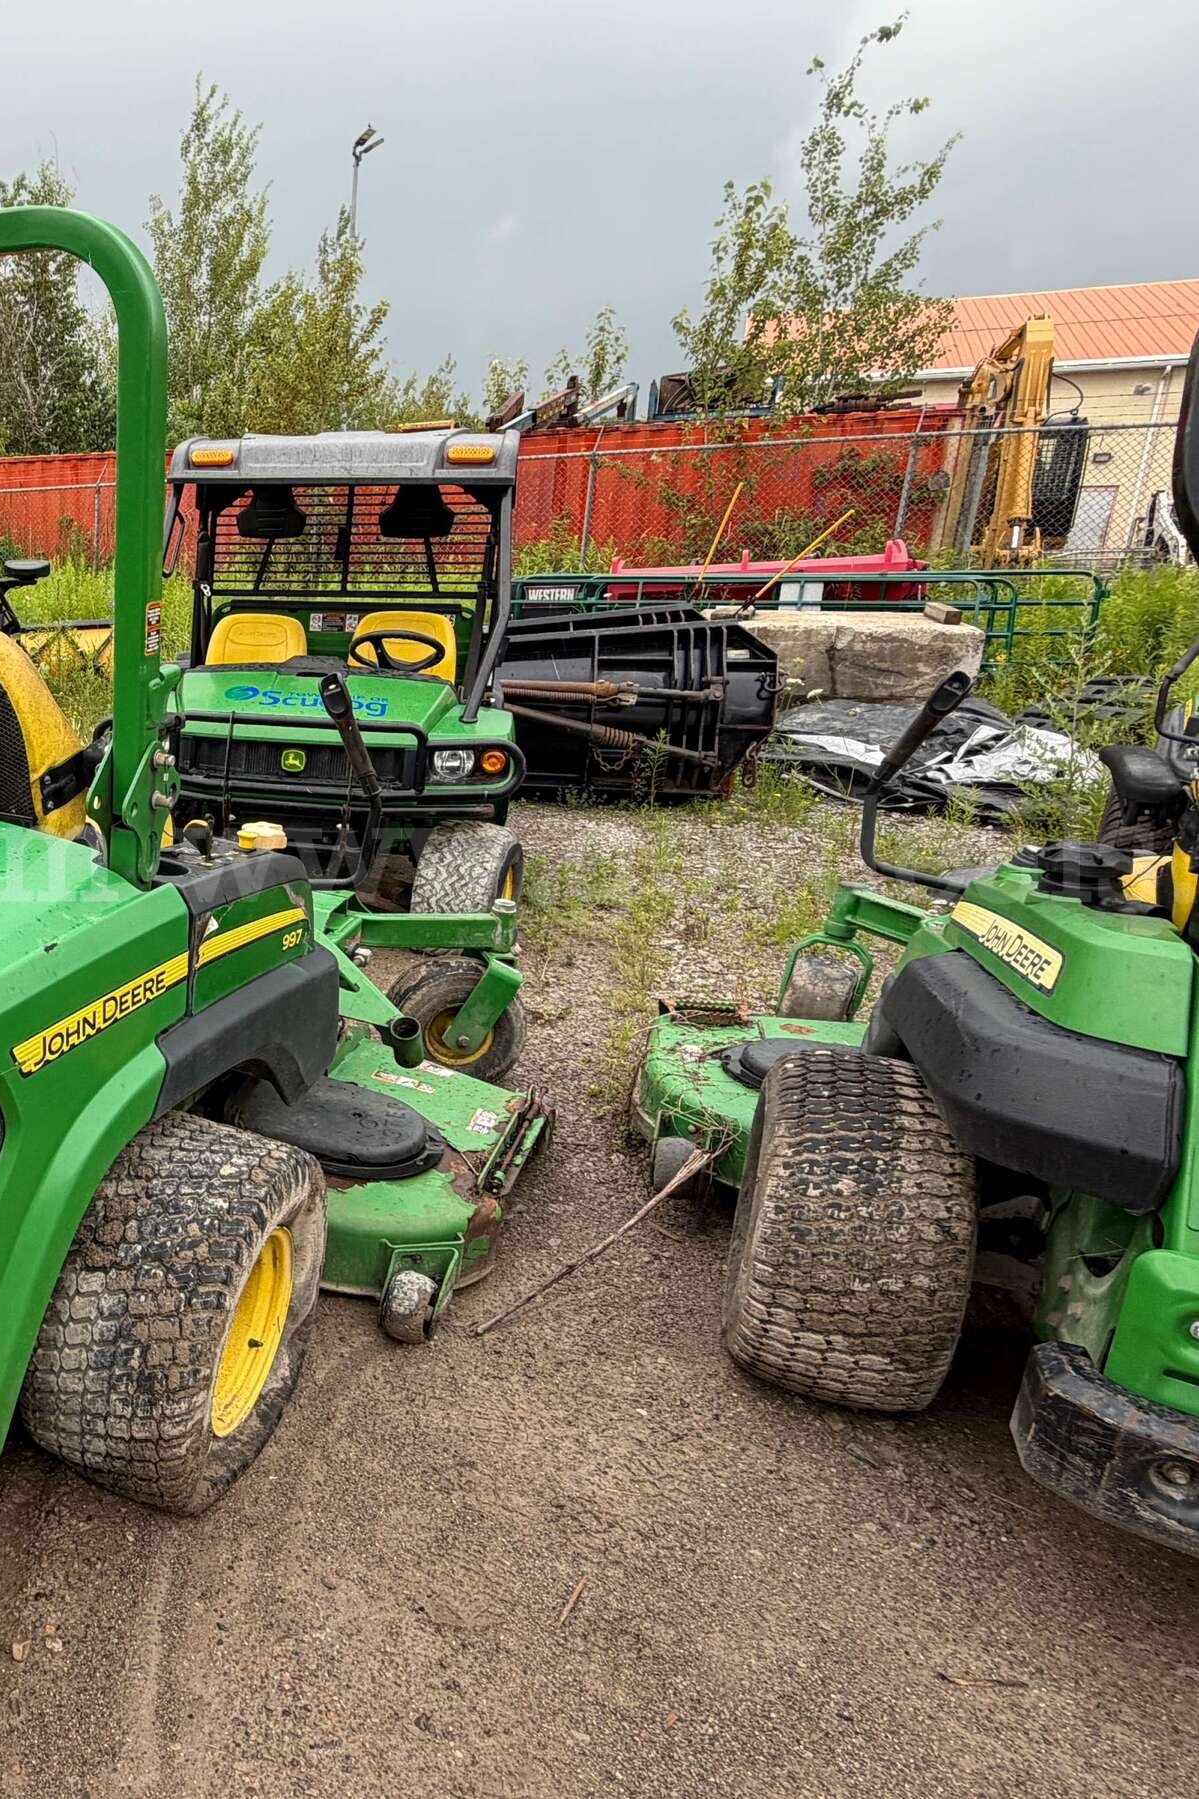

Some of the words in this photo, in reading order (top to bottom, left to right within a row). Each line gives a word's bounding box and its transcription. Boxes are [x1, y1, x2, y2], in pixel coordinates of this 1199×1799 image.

[528, 588, 575, 601] WESTERN
[282, 928, 303, 951] 997
[981, 919, 1012, 954] JOHN
[1006, 934, 1052, 980] DEERE
[33, 1010, 97, 1067] JOHN
[102, 970, 166, 1024] DEERE
